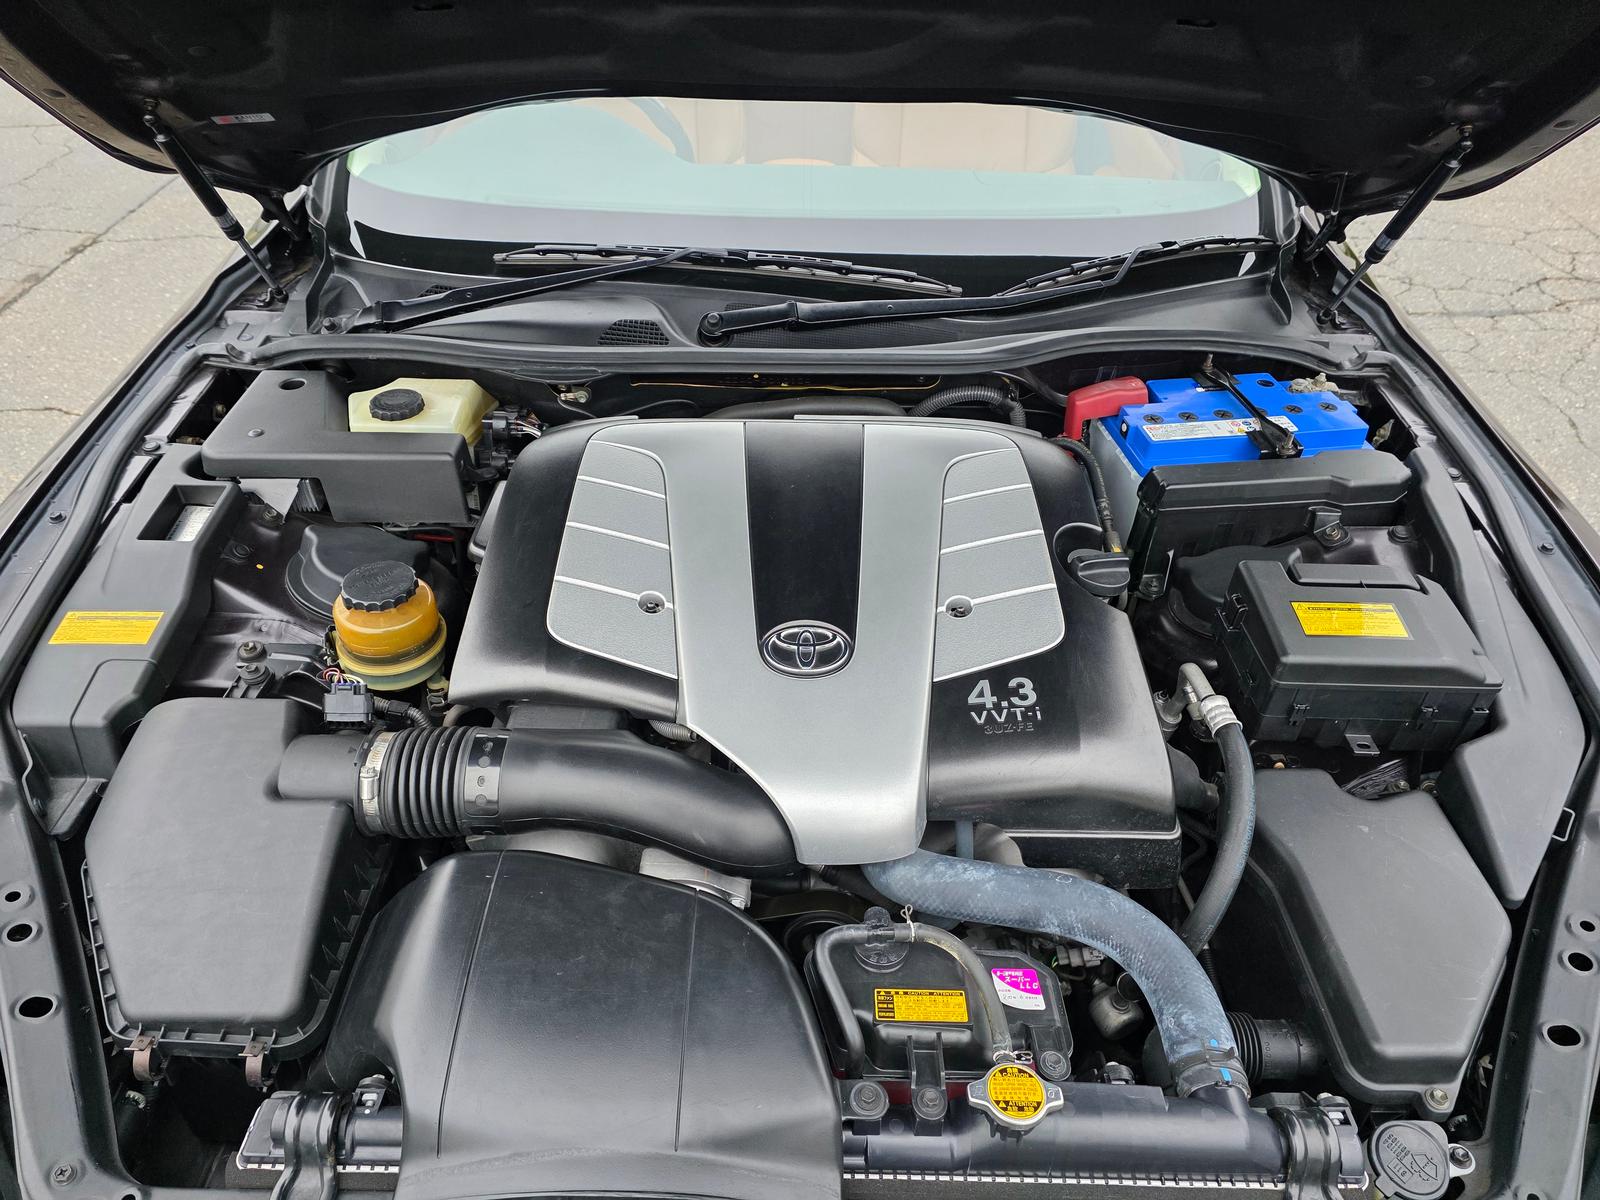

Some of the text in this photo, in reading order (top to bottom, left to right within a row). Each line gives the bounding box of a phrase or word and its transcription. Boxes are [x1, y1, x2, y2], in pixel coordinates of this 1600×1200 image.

[967, 677, 1037, 708] 4.3
[970, 706, 1042, 725] VVT-i
[984, 722, 1034, 735] 3UZ-FE
